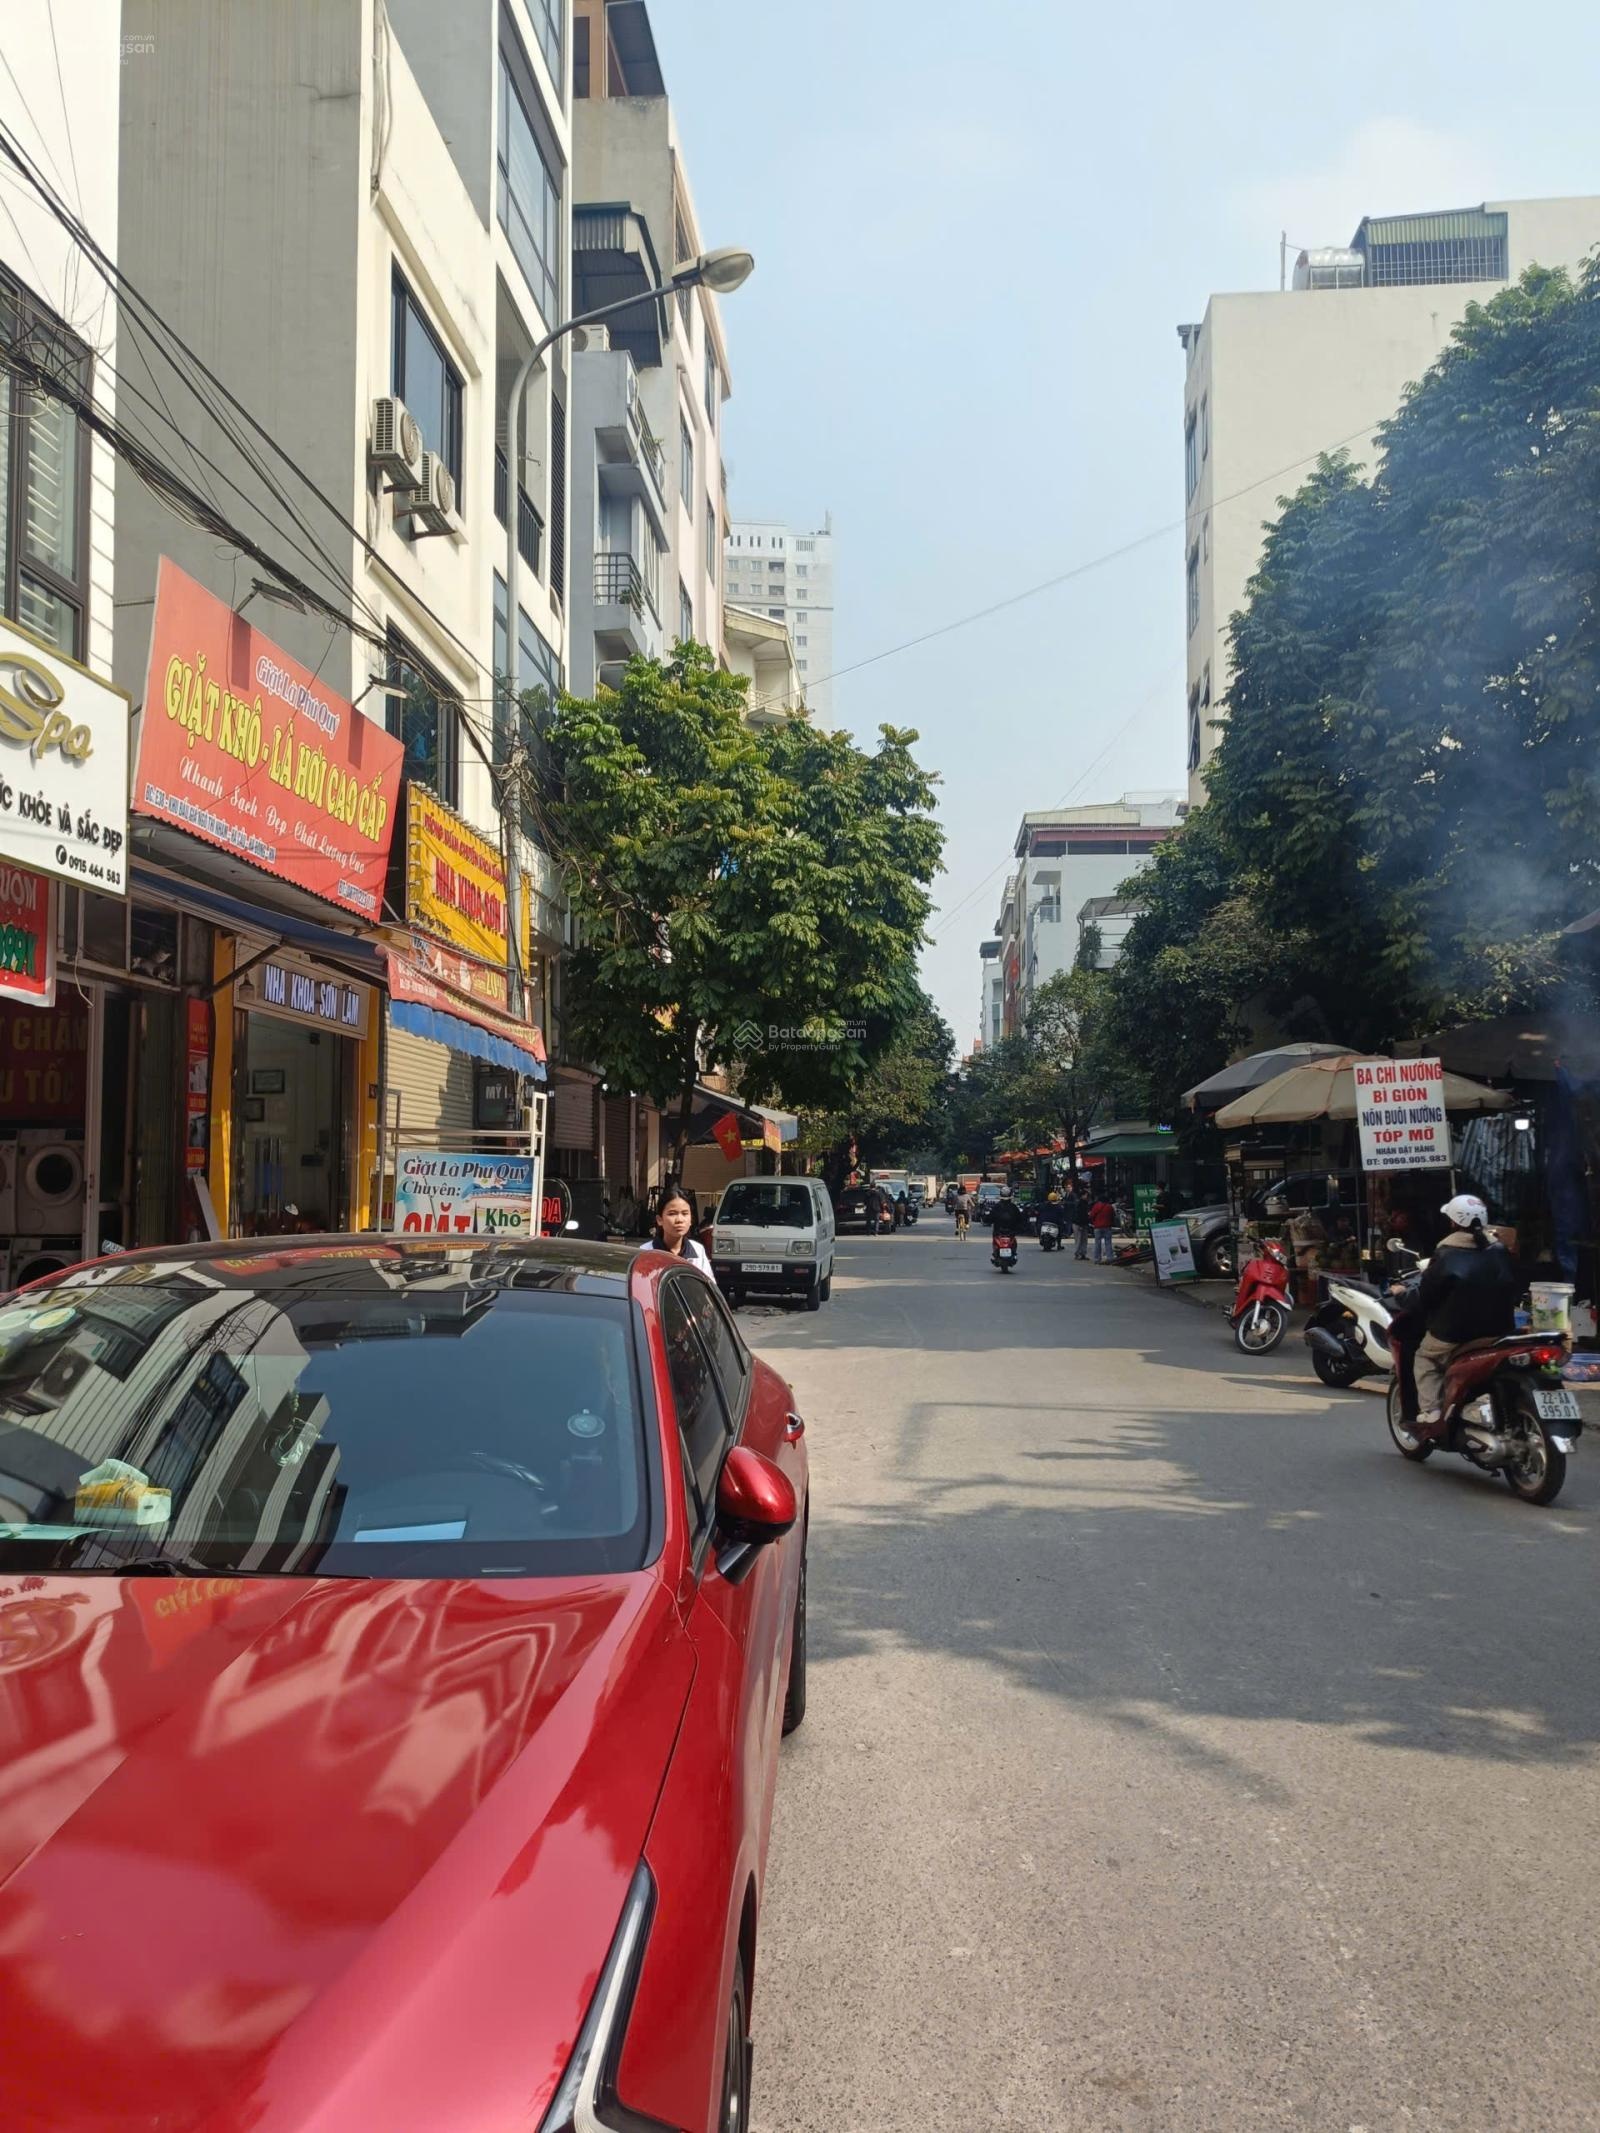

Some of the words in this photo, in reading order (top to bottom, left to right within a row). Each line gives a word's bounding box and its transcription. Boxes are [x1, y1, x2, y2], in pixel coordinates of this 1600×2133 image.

[0, 652, 93, 760] Spa
[164, 650, 221, 750] GIẶT
[218, 690, 262, 769] KHÔ
[268, 717, 294, 791] LÀ
[294, 742, 327, 810] HƠI
[326, 763, 358, 827] CAO
[358, 771, 387, 844] CẤP
[180, 755, 223, 800] Nhanh
[18, 790, 52, 826] KHỎE
[58, 802, 73, 835] VÀ
[77, 809, 100, 845] SẮC
[102, 826, 123, 859] ĐẸP
[69, 855, 87, 873] 0915
[88, 863, 104, 880] 464
[106, 869, 121, 885] 583
[436, 857, 456, 906] NHA
[457, 873, 481, 921] KHOA
[483, 889, 501, 932] SƠN
[265, 963, 286, 1006] NHA
[290, 973, 315, 1014] KHOA
[320, 982, 338, 1020] SƠN
[341, 985, 360, 1025] LÂM
[1356, 1067, 1374, 1085] BA
[1399, 1060, 1443, 1083] NƯỚNG
[1373, 1087, 1388, 1103] BÌ
[1392, 1084, 1428, 1102] GIÒN
[1409, 1105, 1443, 1124] NƯỚNG
[1373, 1128, 1404, 1143] TÓP
[1408, 1125, 1435, 1142] MỠ
[439, 1160, 460, 1178] Là
[461, 1162, 494, 1179] Phú
[1366, 1158, 1381, 1166] ĐT:
[402, 1180, 461, 1199] Chuyên:
[485, 1207, 522, 1228] Khô
